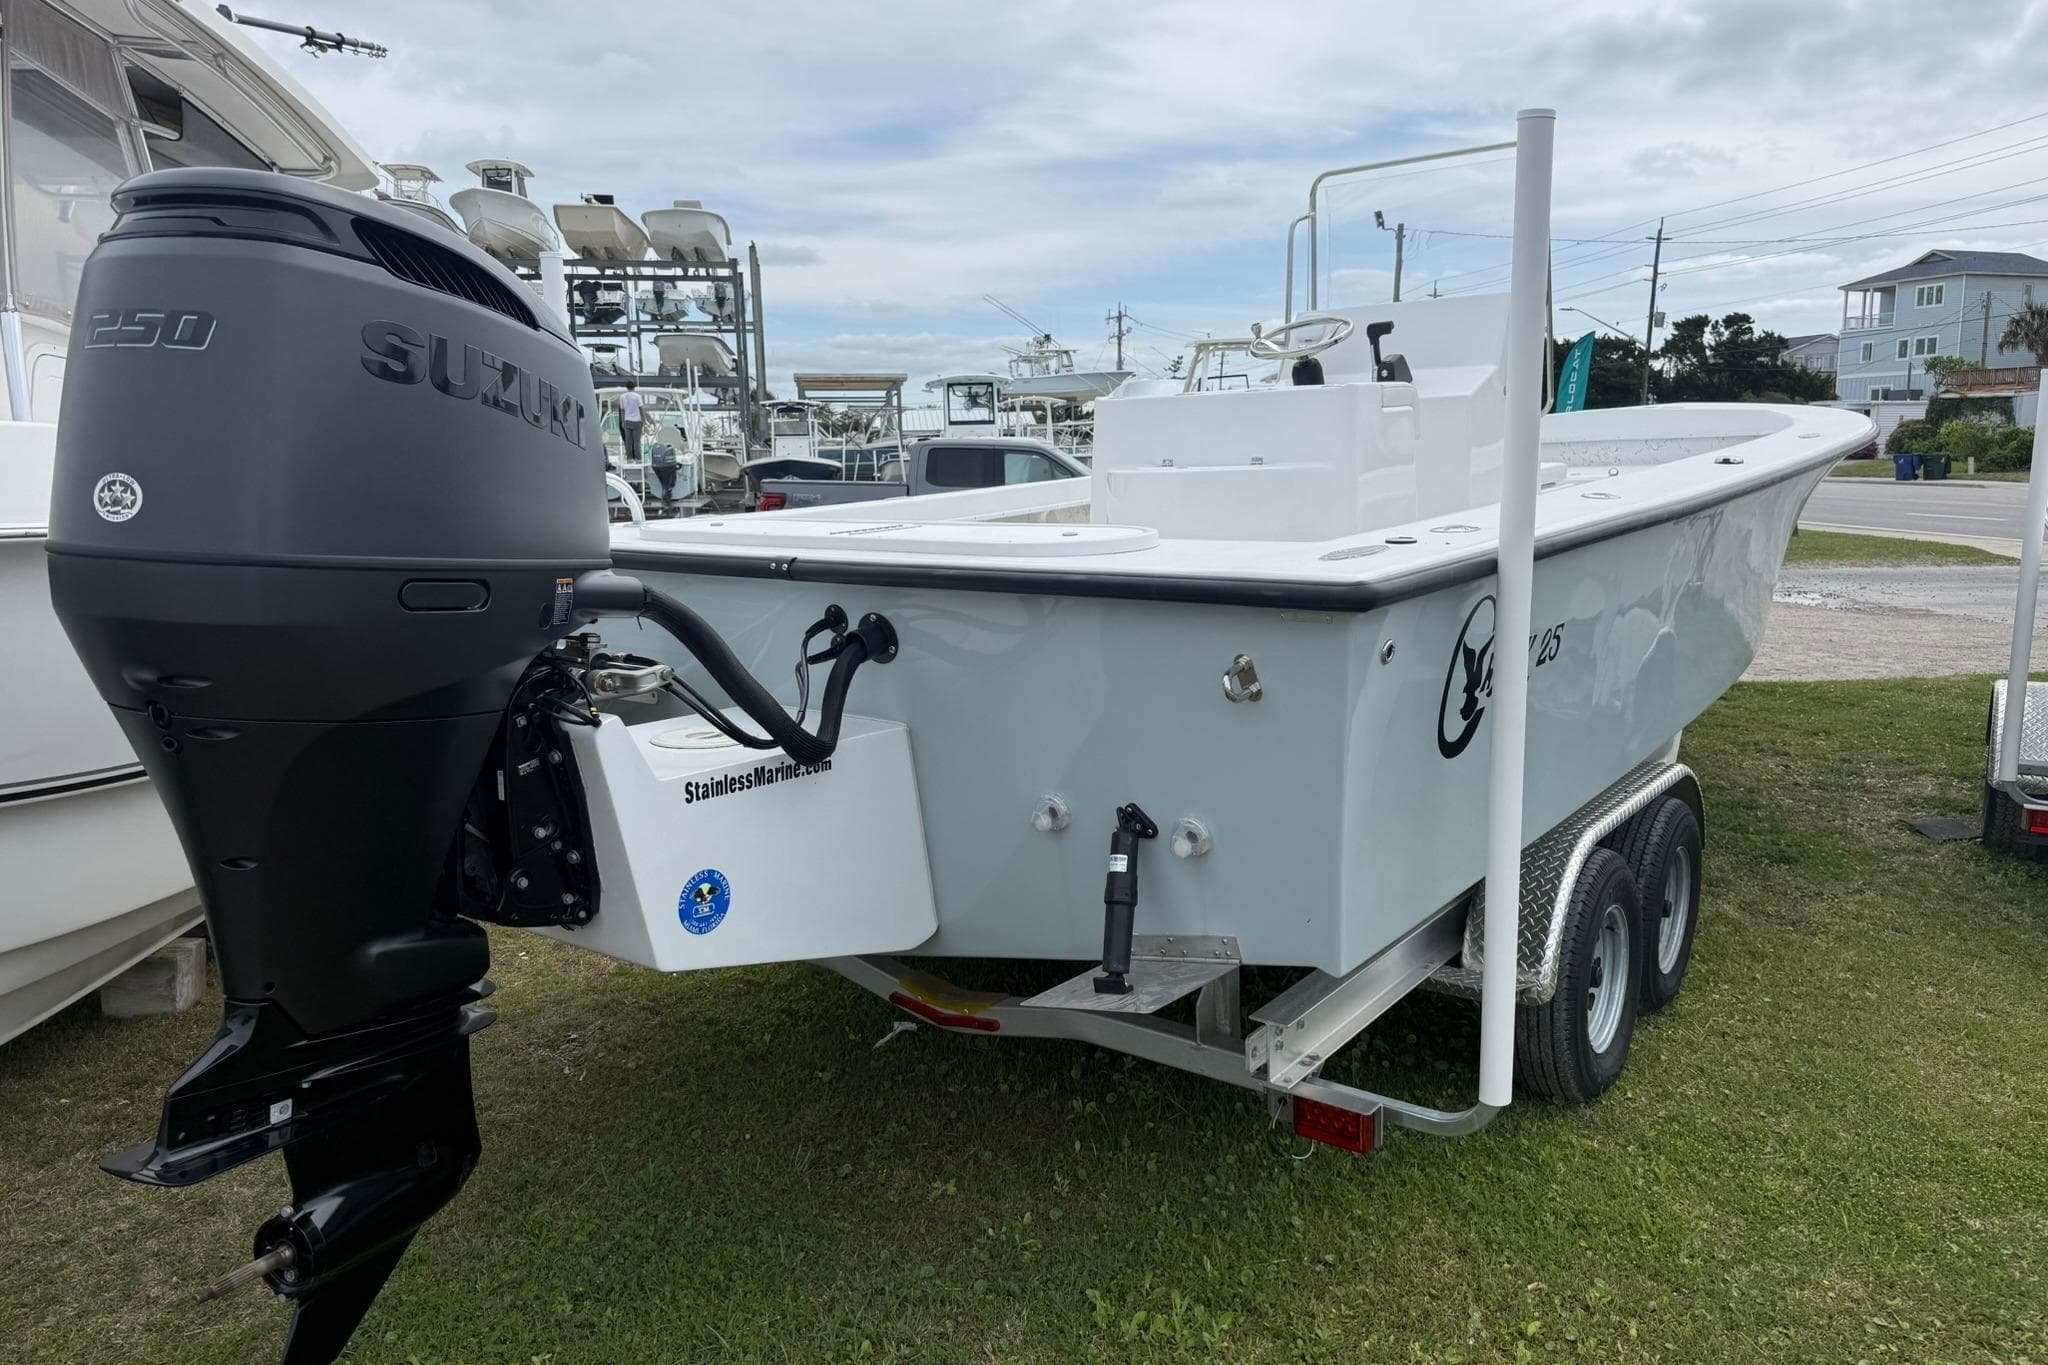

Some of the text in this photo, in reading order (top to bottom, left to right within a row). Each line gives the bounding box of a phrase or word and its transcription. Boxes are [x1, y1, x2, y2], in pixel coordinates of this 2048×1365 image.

[85, 309, 217, 351] 250
[361, 319, 587, 451] SUZUKI
[1535, 622, 1566, 668] 25
[684, 758, 832, 804] StainlessMarine.com
[679, 871, 730, 910] STAINLESS MARINE
